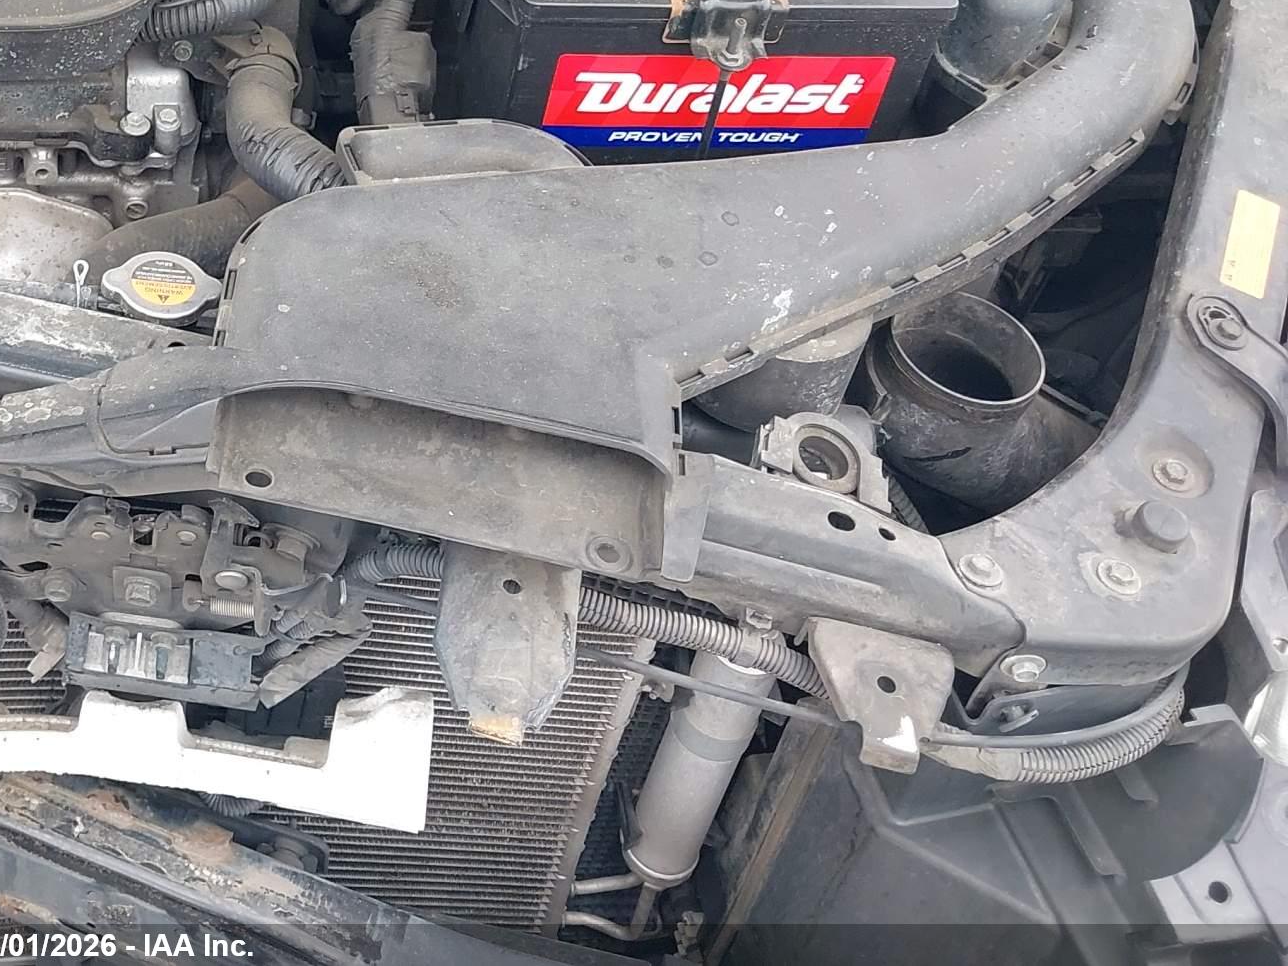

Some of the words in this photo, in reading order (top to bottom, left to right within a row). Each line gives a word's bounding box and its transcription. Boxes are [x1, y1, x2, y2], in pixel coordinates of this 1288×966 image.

[575, 72, 863, 114] Duralast
[608, 131, 703, 143] PROVEN
[717, 131, 799, 143] TOUGH
[144, 287, 183, 295] WARNING
